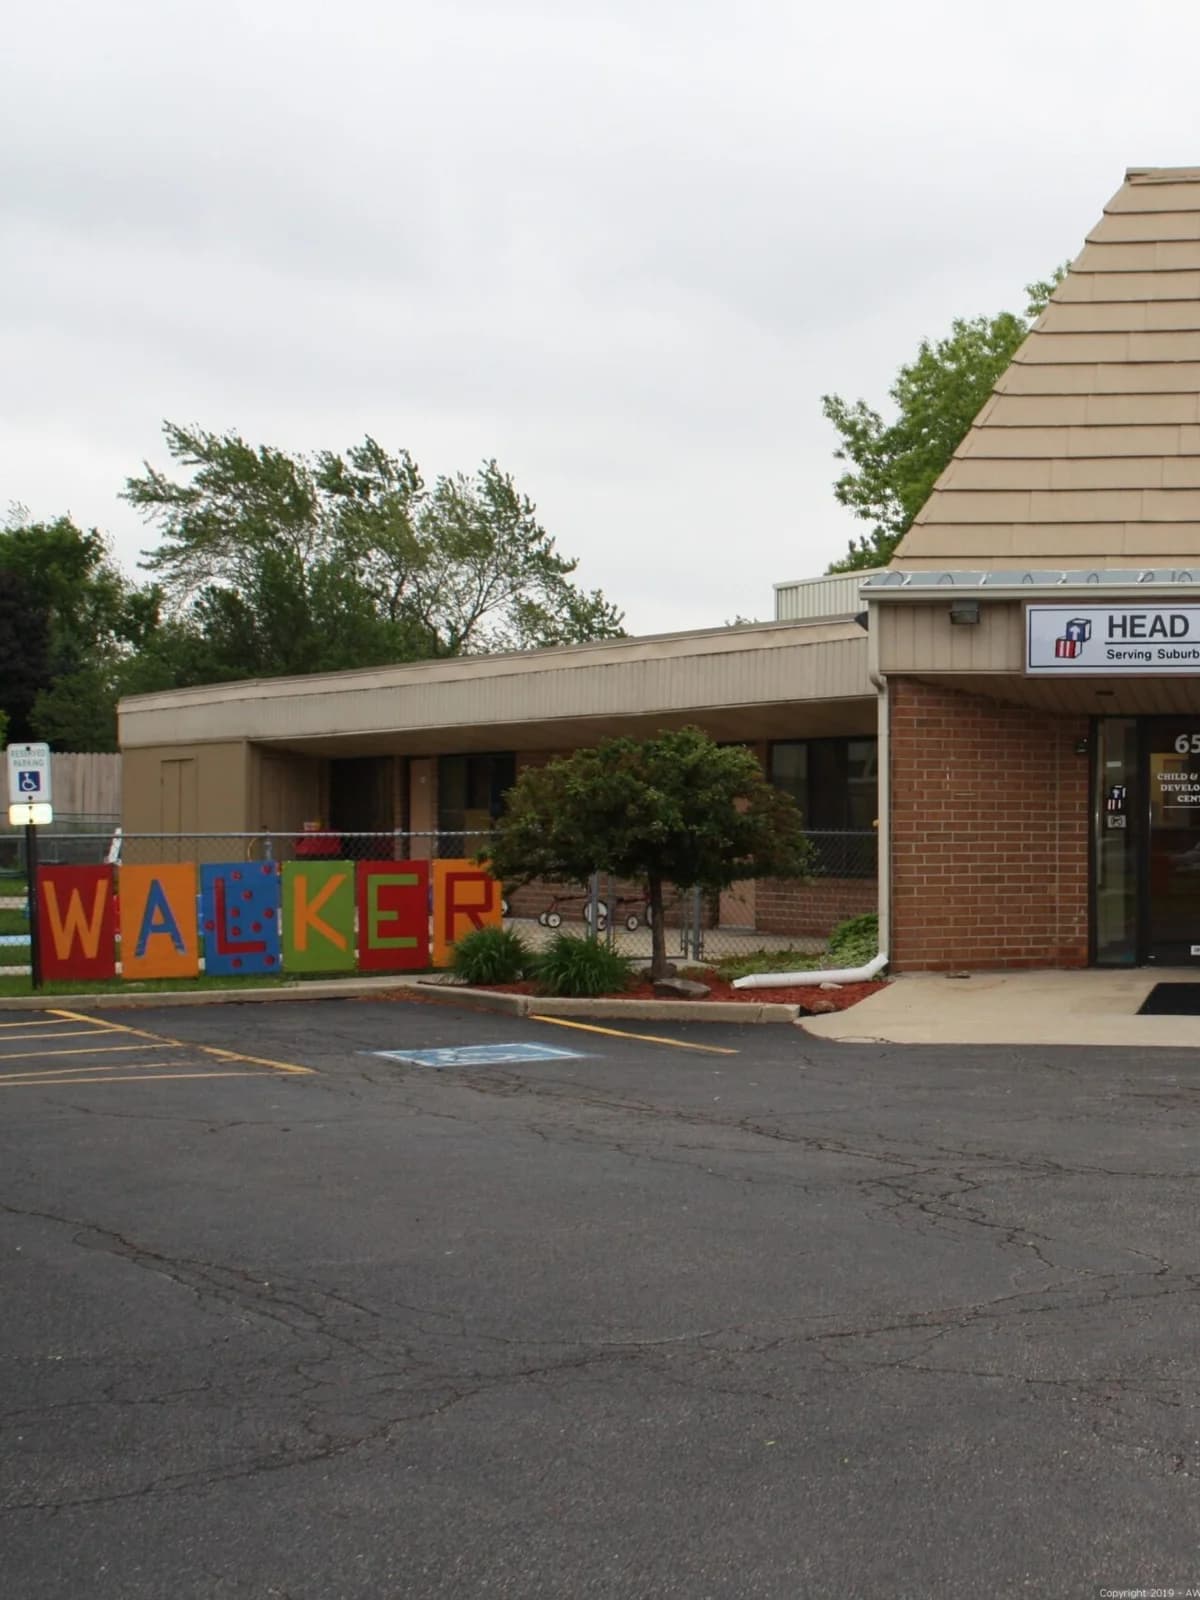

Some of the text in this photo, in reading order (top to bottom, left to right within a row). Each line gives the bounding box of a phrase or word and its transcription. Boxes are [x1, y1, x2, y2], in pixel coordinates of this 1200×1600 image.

[1107, 614, 1189, 638] HEAD
[1106, 649, 1152, 661] Serving
[11, 749, 46, 757] RESERVED
[13, 759, 45, 767] PARKING
[1157, 773, 1188, 781] CHILD
[1190, 773, 1198, 781] &
[42, 871, 494, 960] WALKER
